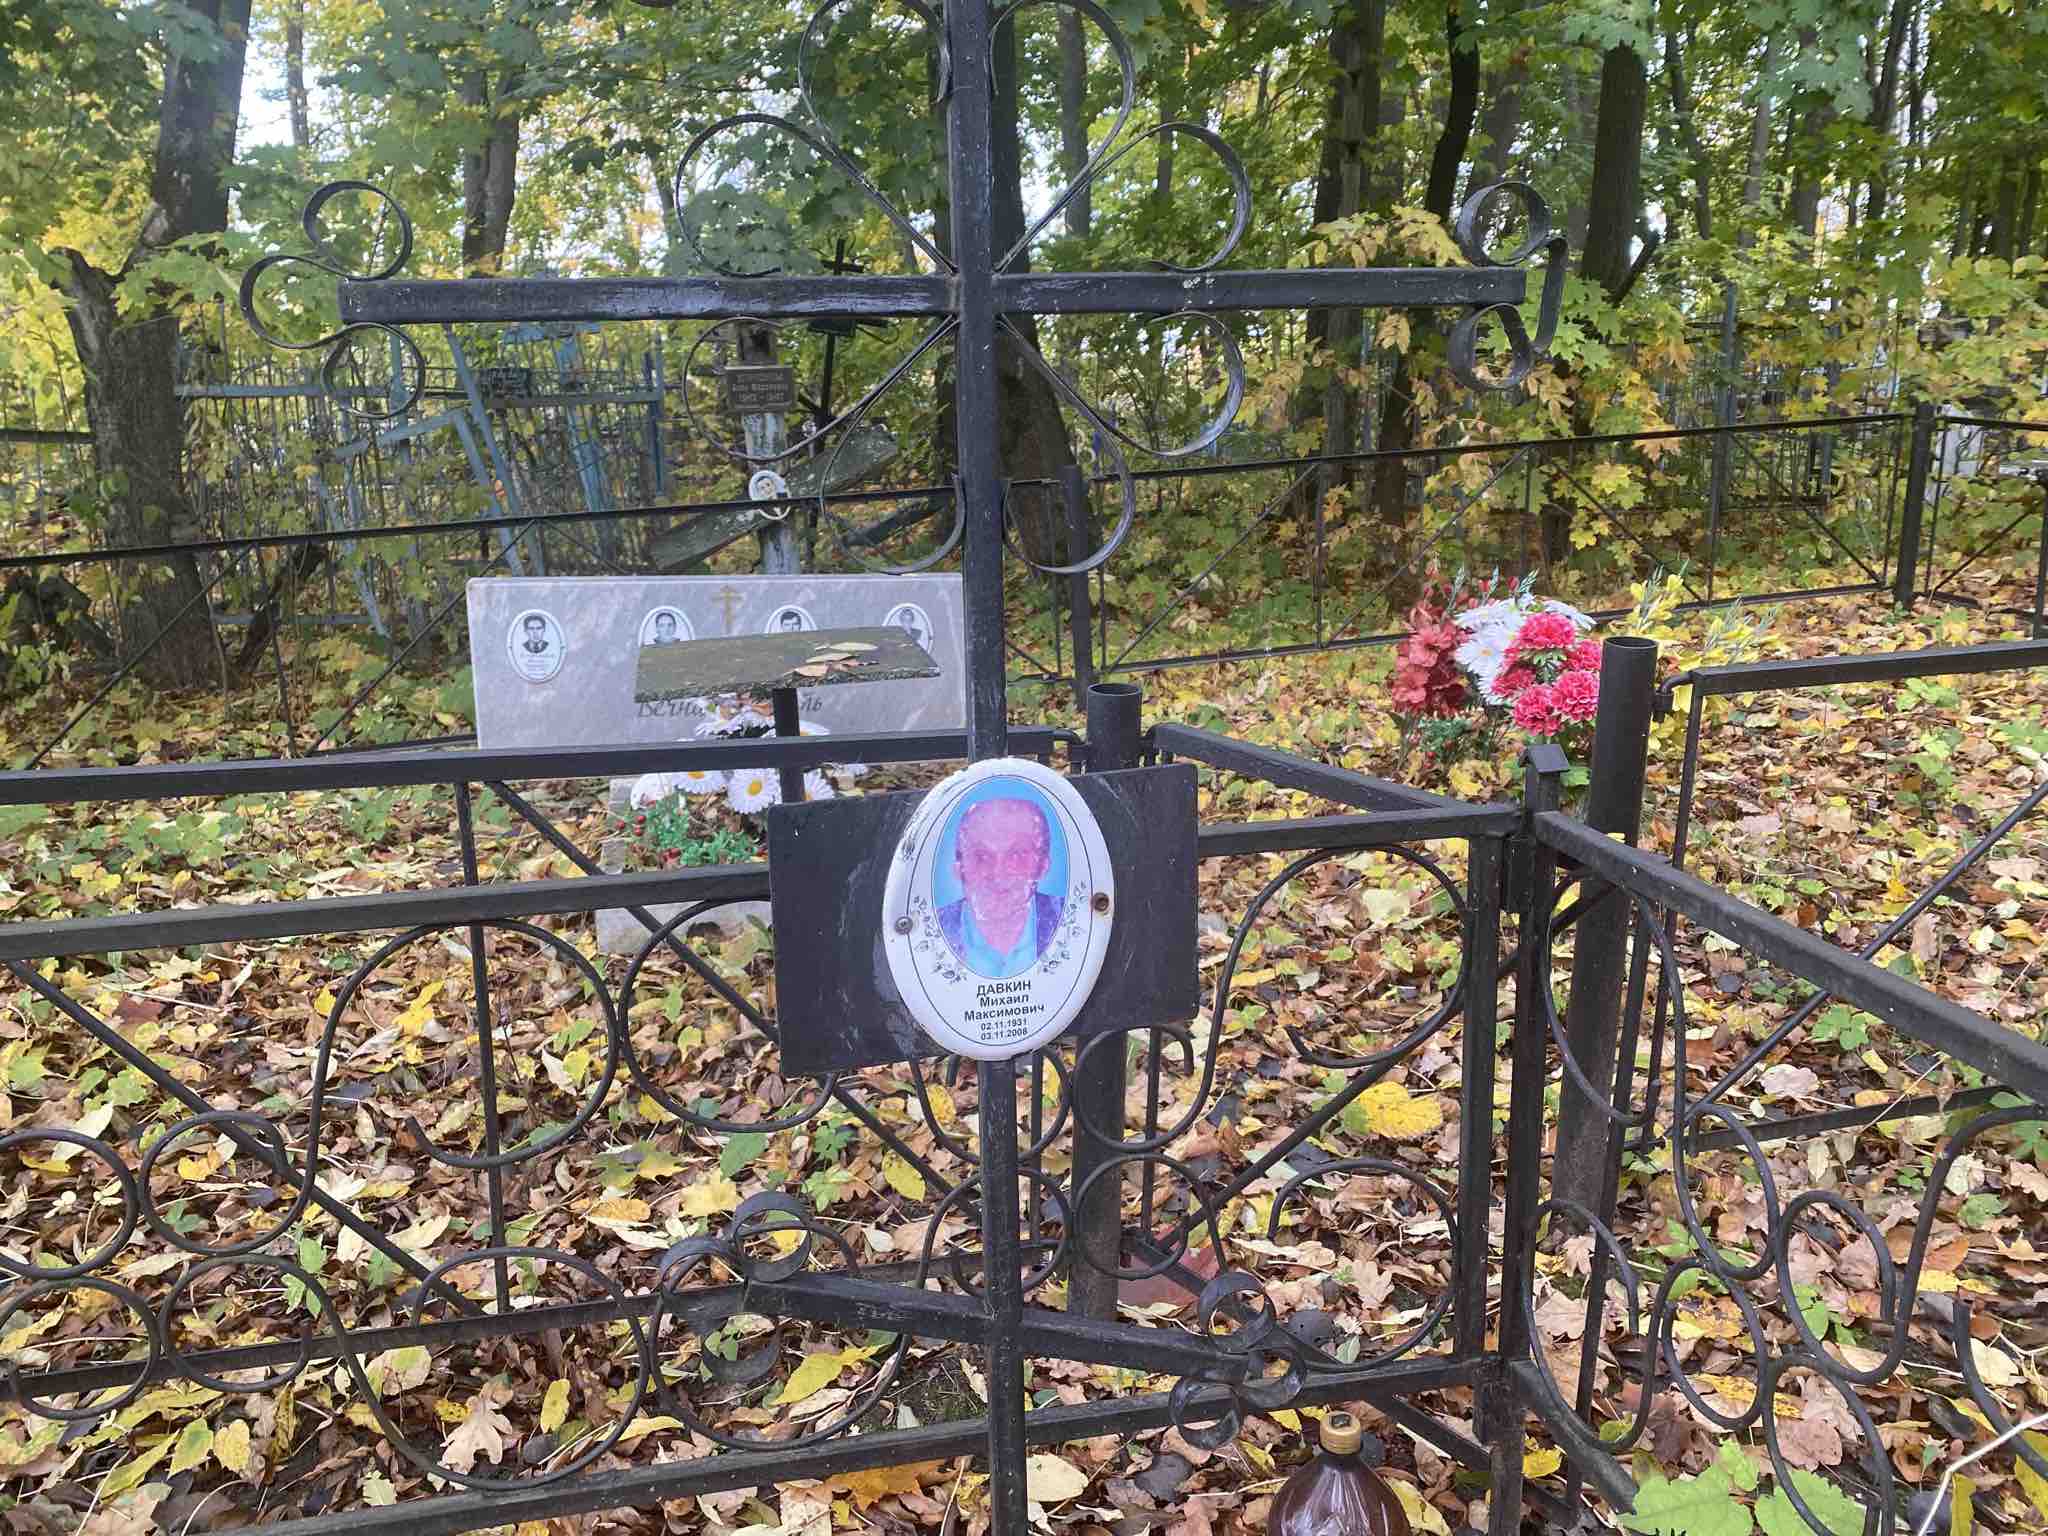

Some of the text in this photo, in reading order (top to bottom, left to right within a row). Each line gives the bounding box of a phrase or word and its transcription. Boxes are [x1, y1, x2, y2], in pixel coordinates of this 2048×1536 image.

[976, 981, 1031, 998] ДАВКИН
[980, 995, 1029, 1008] Михаил
[965, 1005, 1044, 1022] Максимович
[981, 1018, 1027, 1031] 02.11.1931
[981, 1028, 1028, 1040] 03.11.2008
